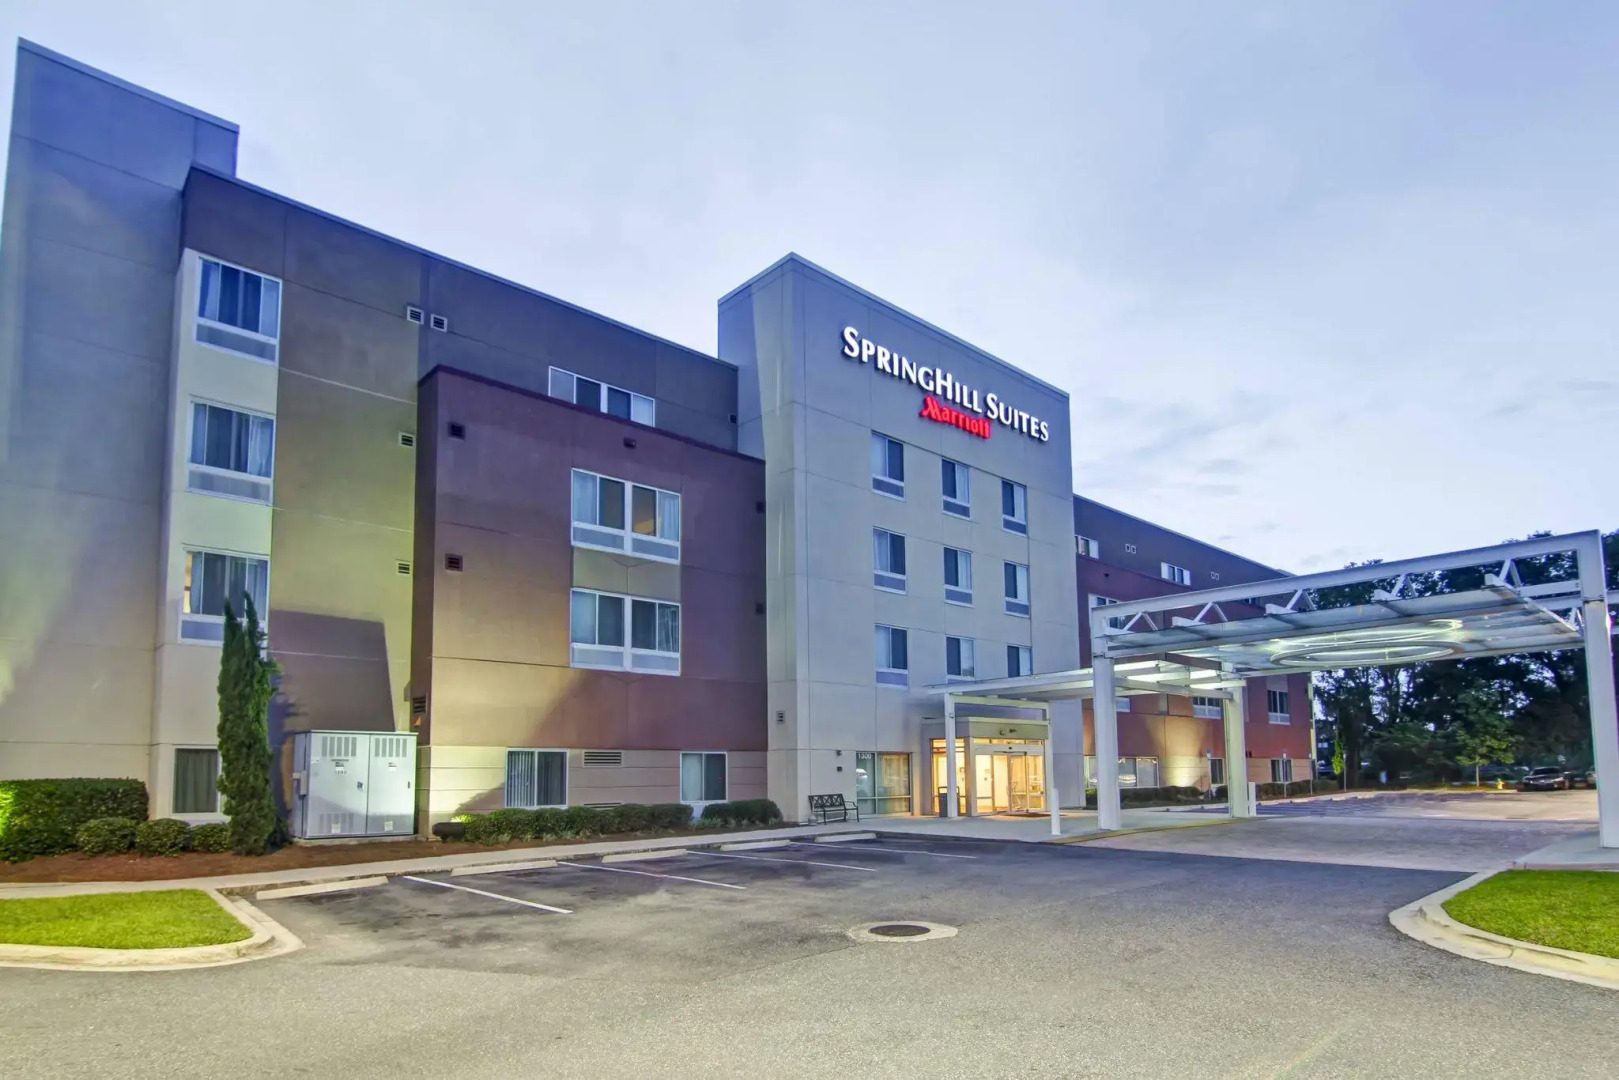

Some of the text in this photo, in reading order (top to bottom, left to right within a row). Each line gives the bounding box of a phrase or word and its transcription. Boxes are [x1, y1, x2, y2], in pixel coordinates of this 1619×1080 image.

[842, 326, 1050, 442] SPRINGHILL SUITES
[920, 395, 992, 440] Marriott
